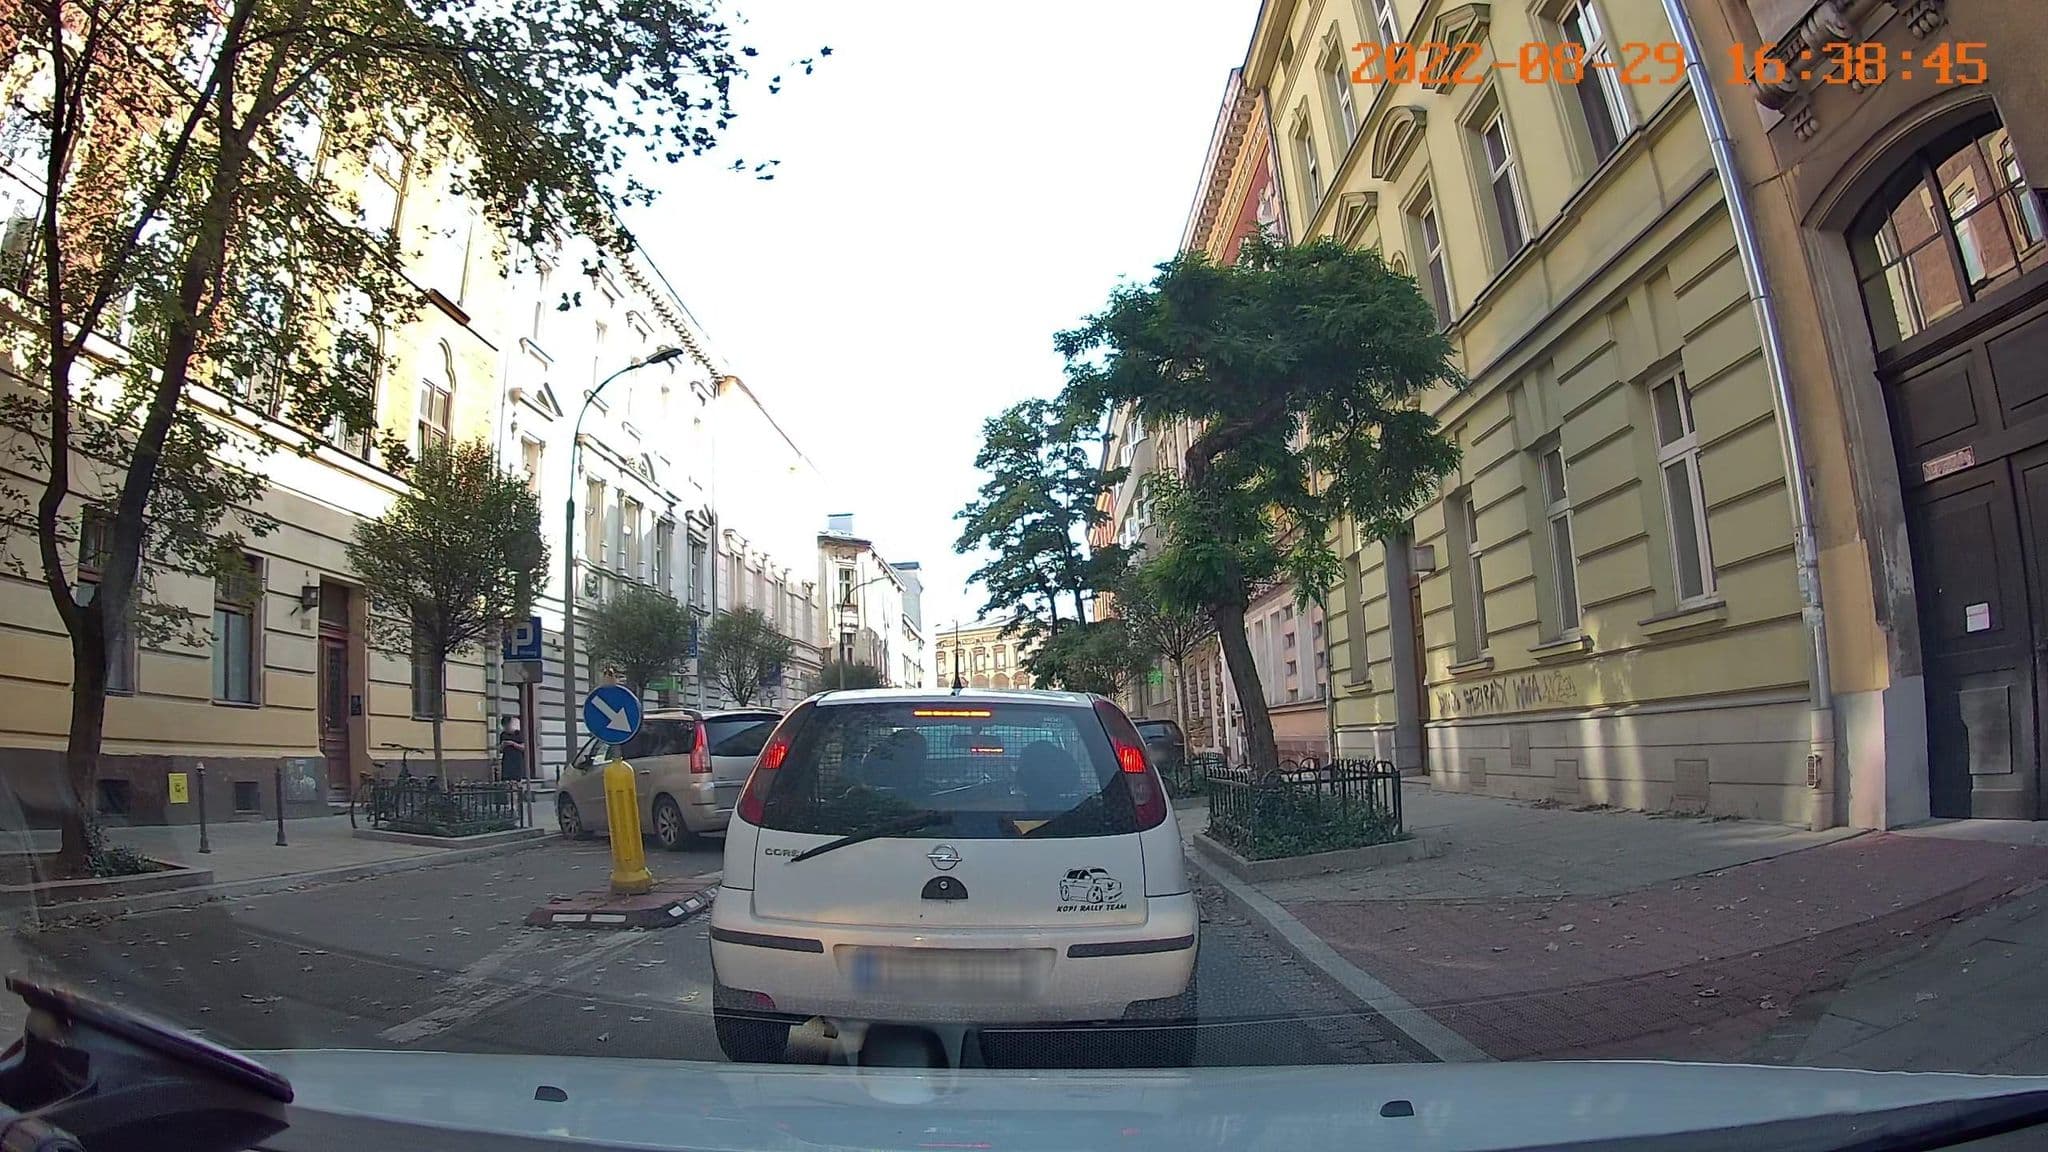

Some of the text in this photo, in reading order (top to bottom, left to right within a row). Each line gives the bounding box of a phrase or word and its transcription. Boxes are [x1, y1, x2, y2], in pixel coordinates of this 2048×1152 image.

[511, 621, 533, 656] P
[1079, 904, 1103, 912] RALLY
[1106, 903, 1127, 911] TEAM
